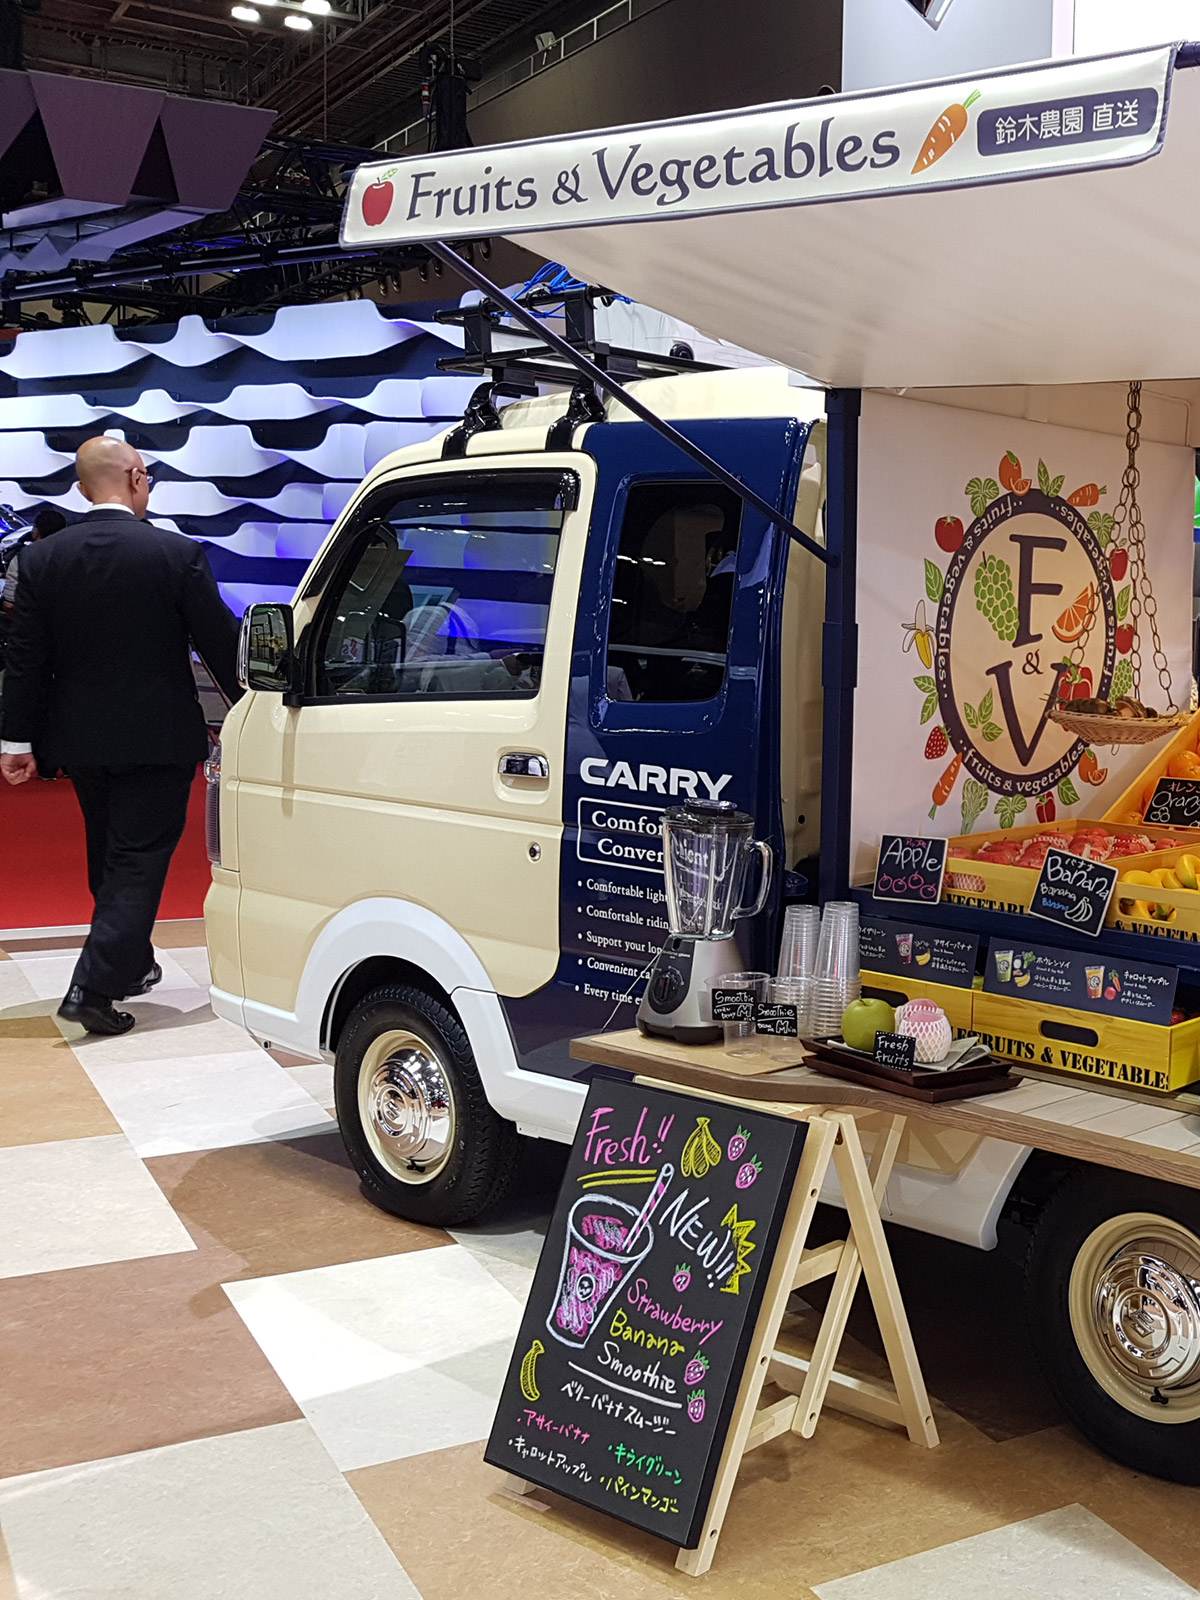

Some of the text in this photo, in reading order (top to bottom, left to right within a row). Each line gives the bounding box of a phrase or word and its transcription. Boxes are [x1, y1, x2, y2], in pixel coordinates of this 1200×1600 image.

[995, 98, 1140, 146] 鈴木農園 直送
[405, 116, 901, 221] Fruits & Vegetables
[973, 496, 1012, 537] fruits
[1009, 533, 1068, 648] F
[938, 554, 966, 682] vegetables
[1022, 648, 1044, 676] &
[1103, 614, 1115, 677] fruits
[985, 659, 1067, 767] V
[579, 757, 733, 800] CARRY
[963, 742, 1085, 794] fruits & vegetables
[881, 838, 942, 871] Apple
[586, 878, 644, 898] Comfortable
[1040, 882, 1077, 902] Banana
[586, 905, 644, 925] Comfortable
[586, 930, 622, 948] Support
[624, 941, 646, 952] your
[587, 957, 638, 977] Convenient
[584, 983, 609, 1001] Every
[611, 990, 633, 1003] time
[875, 1050, 910, 1067] fruits
[878, 1035, 909, 1052] Fresh
[1041, 1047, 1054, 1064] &
[584, 1107, 675, 1165] Fresh!!
[659, 1188, 735, 1289] NEW!!
[609, 1307, 685, 1357] Banana
[627, 1278, 723, 1346] Strawberry
[597, 1341, 677, 1394] Smoothie
